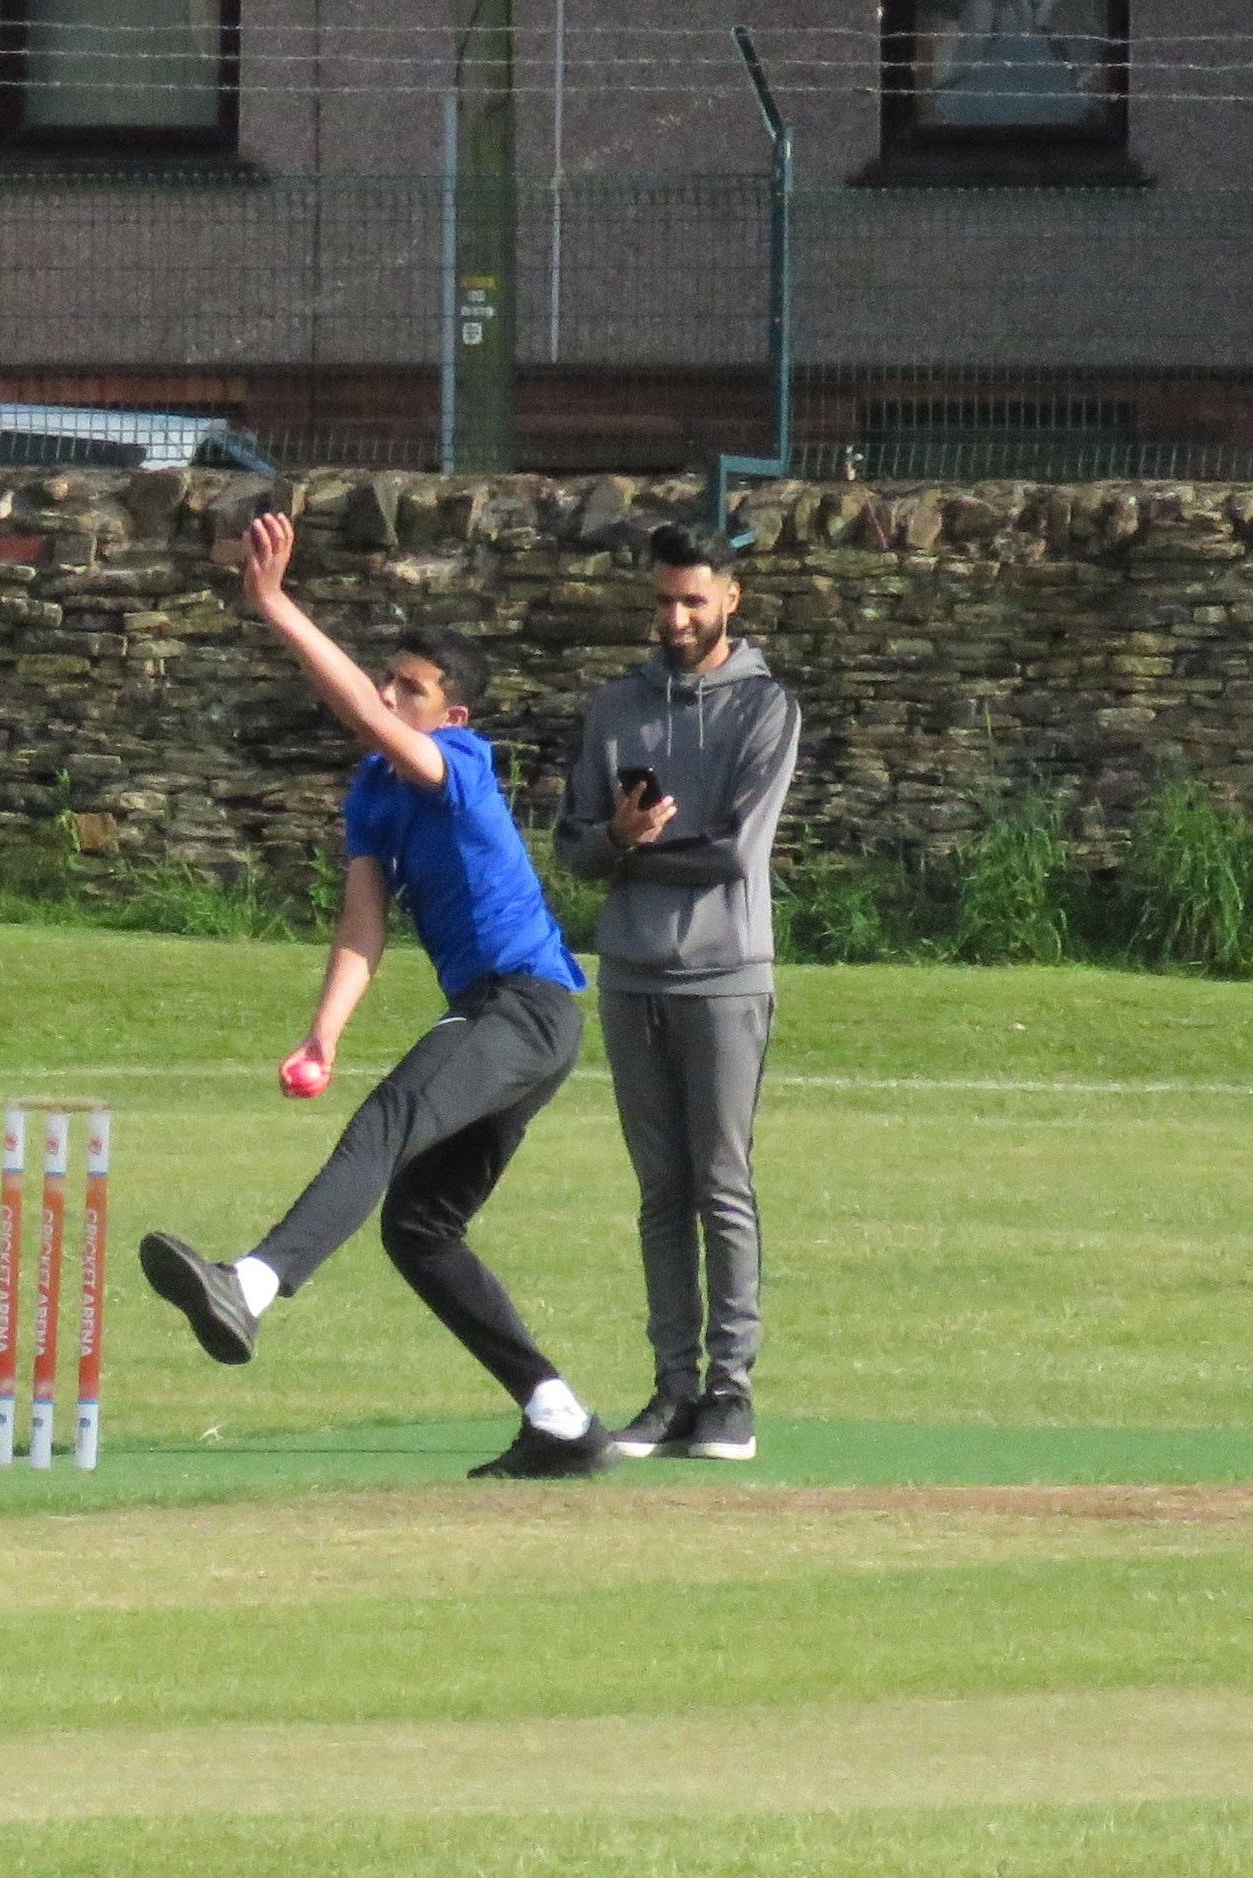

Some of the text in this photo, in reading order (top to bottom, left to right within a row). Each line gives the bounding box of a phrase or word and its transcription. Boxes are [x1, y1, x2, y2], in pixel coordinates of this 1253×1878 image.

[0, 1205, 12, 1286] CRICKET
[35, 1209, 53, 1356] CRICKET ARENA
[81, 1209, 97, 1356] CRICKET ARENA
